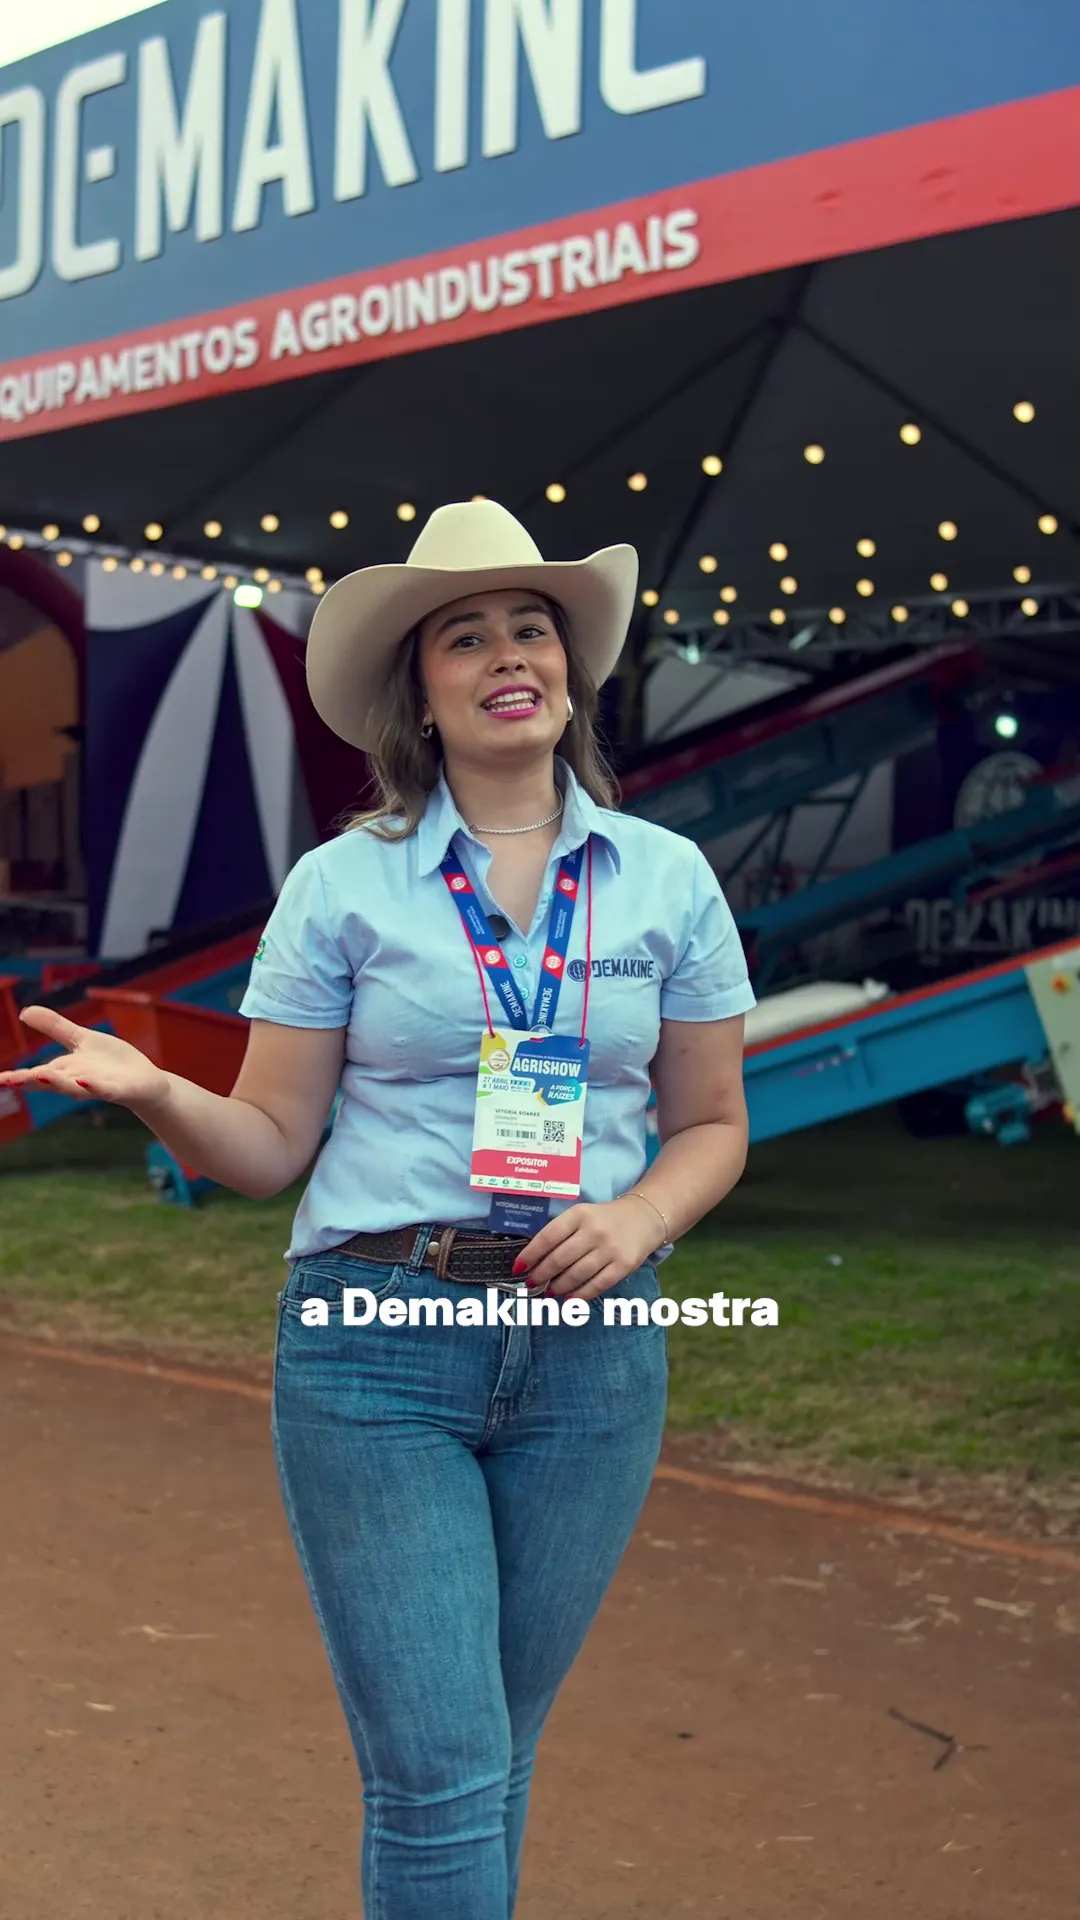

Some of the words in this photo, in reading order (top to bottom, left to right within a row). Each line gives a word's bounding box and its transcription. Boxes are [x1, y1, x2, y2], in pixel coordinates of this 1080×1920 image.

[270, 207, 700, 362] AGROINDUSTRIAIS
[591, 958, 655, 979] DEMAKINE
[500, 979, 523, 1018] DEMAKINE
[537, 986, 553, 1025] DEMAKINE
[512, 1057, 582, 1078] AGRISHOW
[506, 1156, 548, 1168] EXPOSITOR
